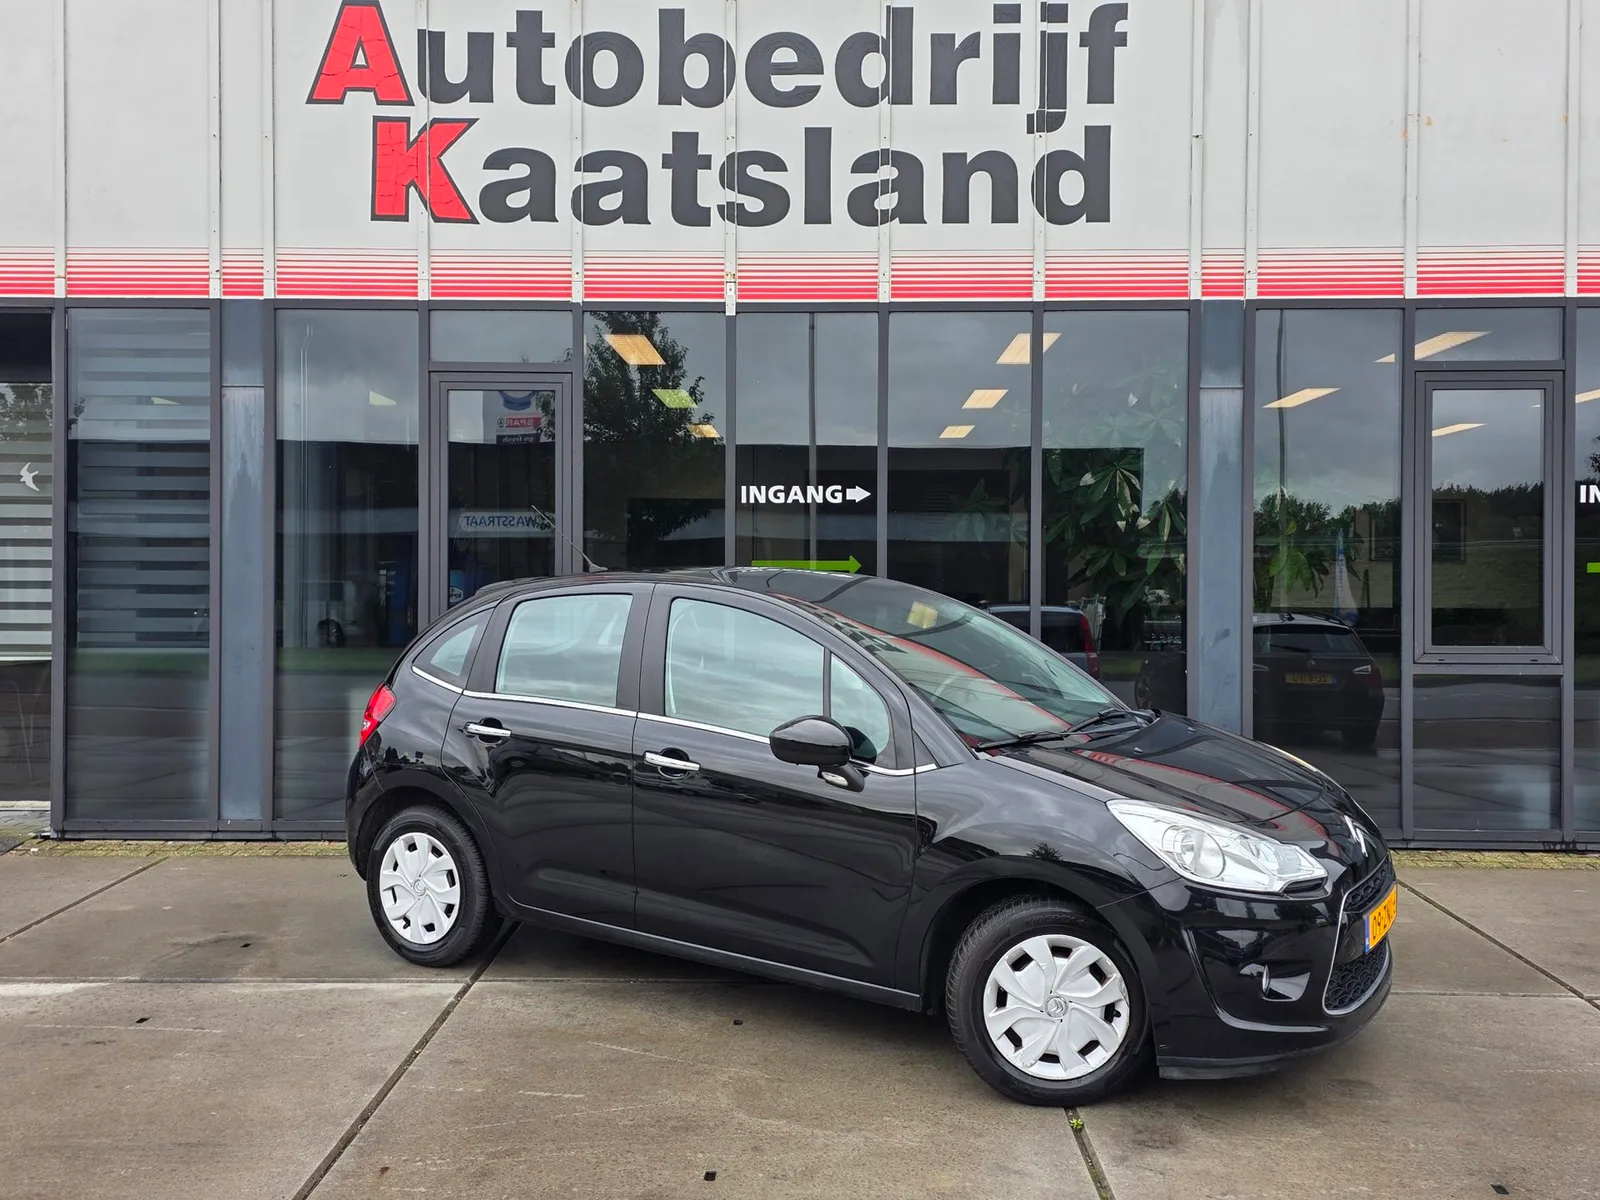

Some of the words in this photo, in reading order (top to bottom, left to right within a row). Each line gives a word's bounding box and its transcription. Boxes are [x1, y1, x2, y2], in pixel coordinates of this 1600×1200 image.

[305, 0, 1129, 134] Autobedrijf
[371, 115, 1112, 227] Kaatsland
[740, 485, 843, 504] INGANG
